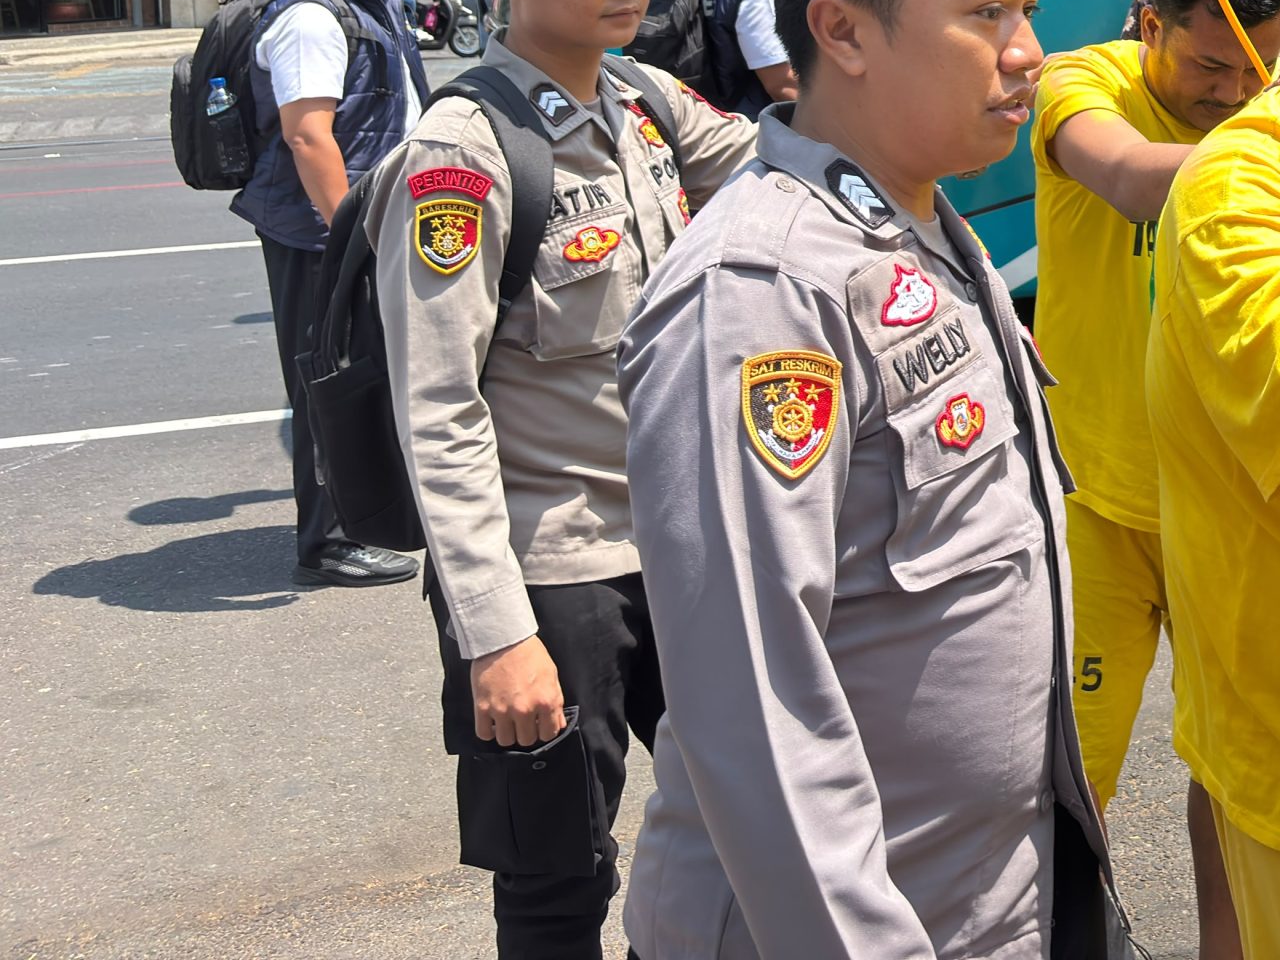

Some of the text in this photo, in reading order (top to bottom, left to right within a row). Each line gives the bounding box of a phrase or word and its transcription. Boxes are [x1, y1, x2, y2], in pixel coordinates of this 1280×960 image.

[413, 170, 486, 192] PERINTIS
[421, 204, 476, 215] BARESKRIM
[892, 317, 970, 392] WELLY
[750, 358, 833, 378] SAT RESKRIM
[1073, 656, 1103, 692] 5
